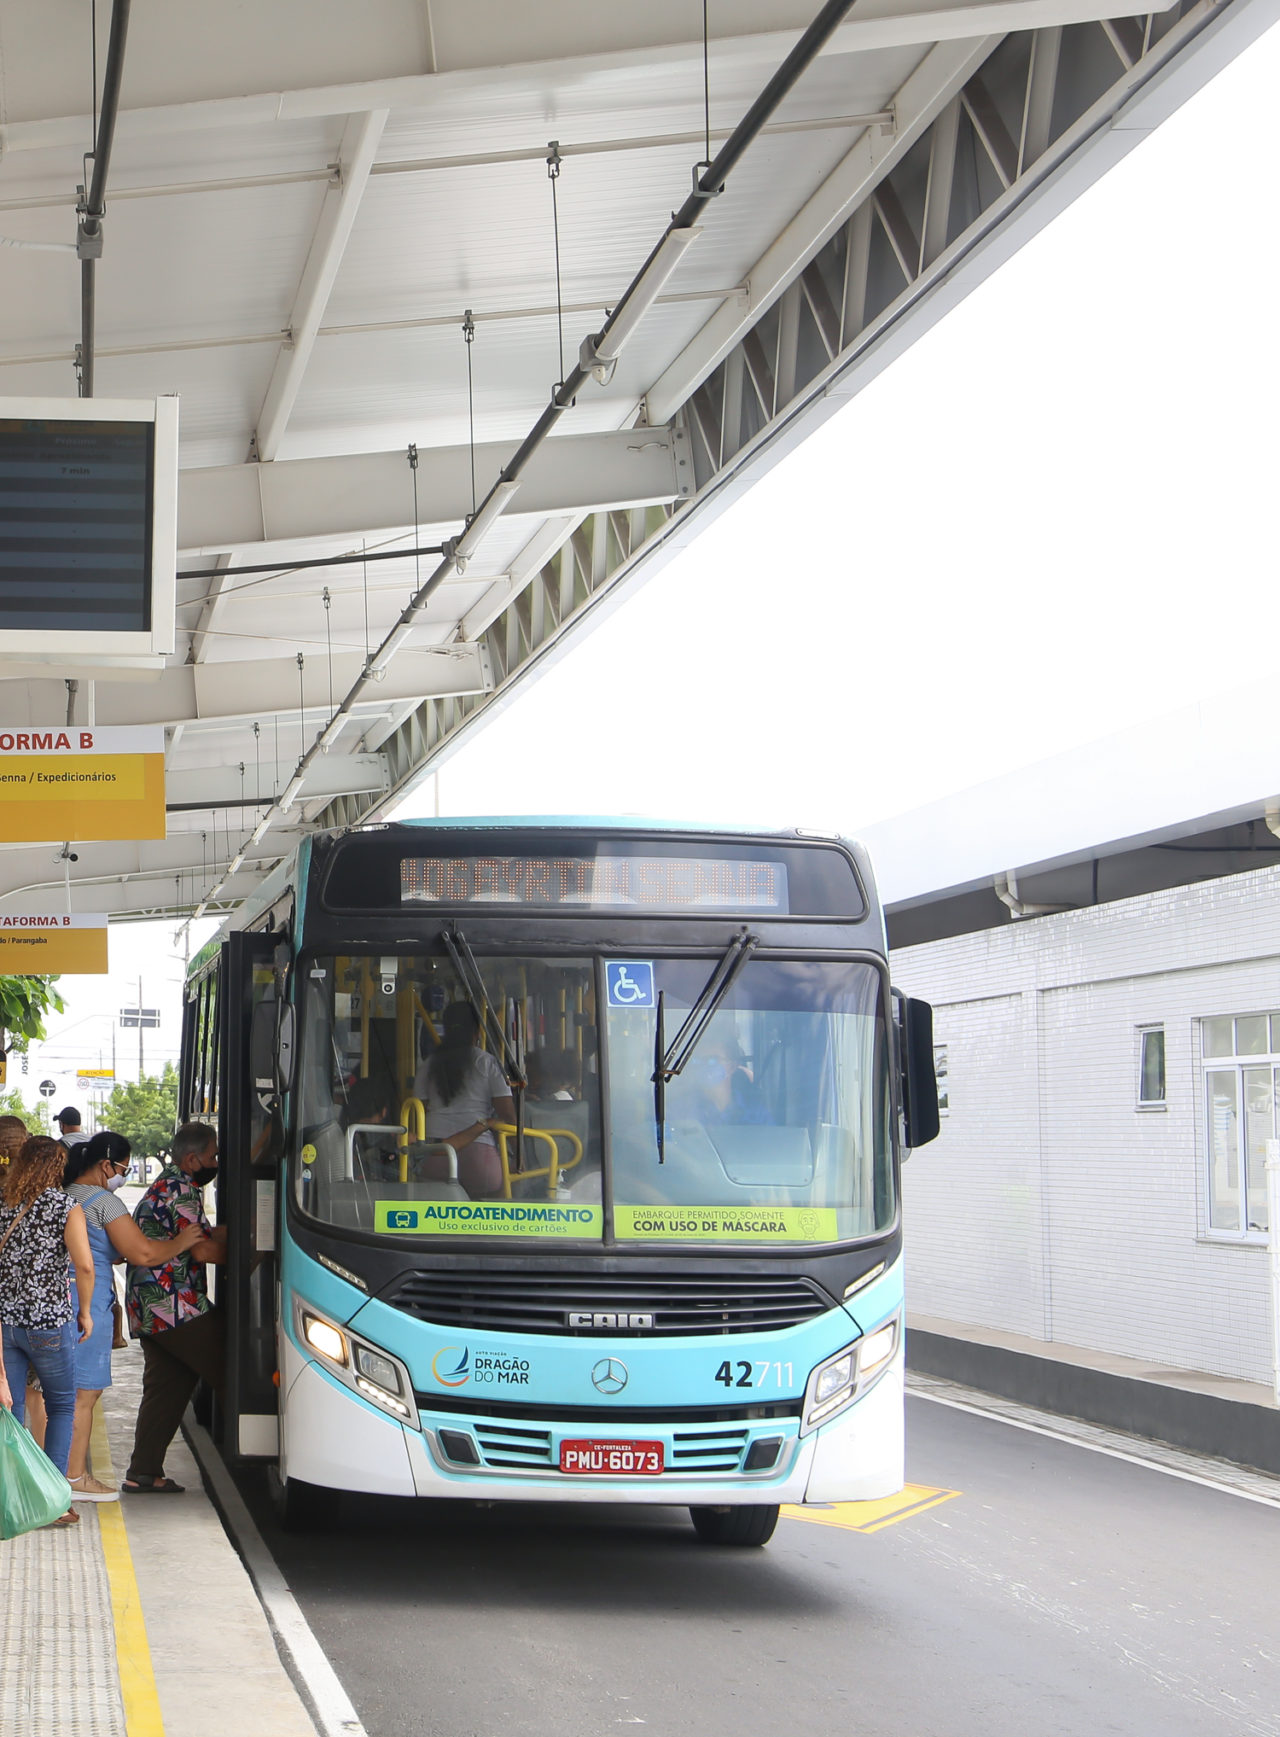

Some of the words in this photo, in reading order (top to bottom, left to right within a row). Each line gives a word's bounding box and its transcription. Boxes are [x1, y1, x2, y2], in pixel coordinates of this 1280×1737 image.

[79, 732, 94, 749] B
[29, 772, 35, 784] /
[37, 771, 116, 785] Expedicionários
[401, 859, 469, 901] 406
[473, 860, 630, 902] AYRTON
[639, 862, 776, 904] SENNA
[63, 916, 70, 925] B
[11, 936, 47, 945] Parangaba
[424, 1206, 594, 1223] AUTOATENDIMENTO
[633, 1210, 684, 1220] EMBARQUE
[687, 1210, 737, 1220] PERMITIDO
[740, 1211, 785, 1220] SOMENTE
[438, 1221, 458, 1231] Uso
[461, 1222, 510, 1232] exclusivo
[512, 1223, 525, 1232] de
[528, 1223, 567, 1233] cartões
[633, 1220, 665, 1232] COM
[669, 1220, 698, 1232] USO
[702, 1221, 718, 1232] DE
[722, 1217, 787, 1232] MÁSCARA
[570, 1313, 653, 1328] CAIO
[475, 1356, 530, 1371] DRAGÃO
[475, 1371, 493, 1383] DO
[498, 1372, 529, 1384] MAR
[715, 1360, 793, 1387] 42711
